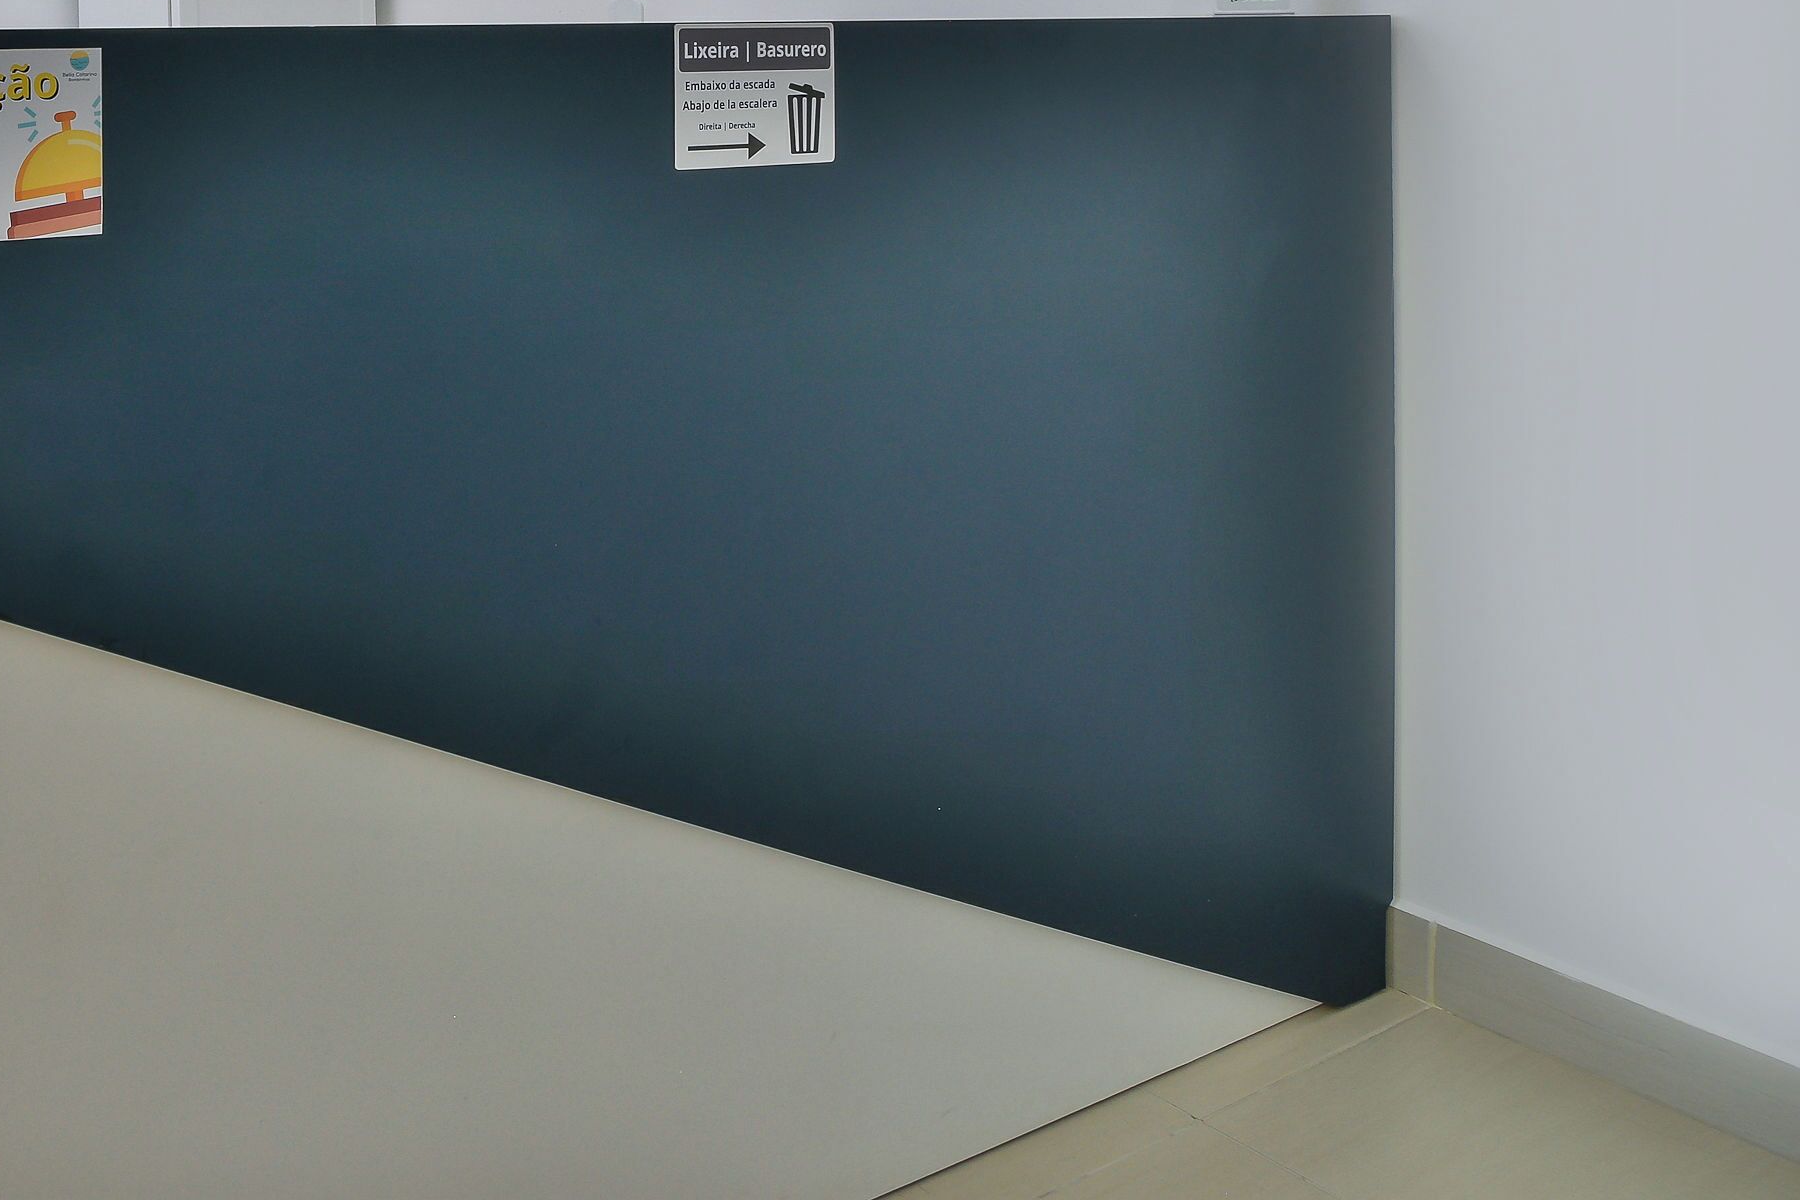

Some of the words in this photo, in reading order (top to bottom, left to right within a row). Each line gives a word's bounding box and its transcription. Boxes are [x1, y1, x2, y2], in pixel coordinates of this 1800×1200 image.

[684, 42, 738, 59] Lixeira
[757, 41, 826, 58] Basurero
[685, 81, 726, 91] Embaixo
[729, 80, 741, 90] da
[744, 79, 776, 89] escada
[683, 100, 710, 113] Abajo
[714, 99, 724, 110] de
[728, 99, 736, 109] la
[739, 99, 778, 108] escalera
[729, 122, 755, 130] Derecha
